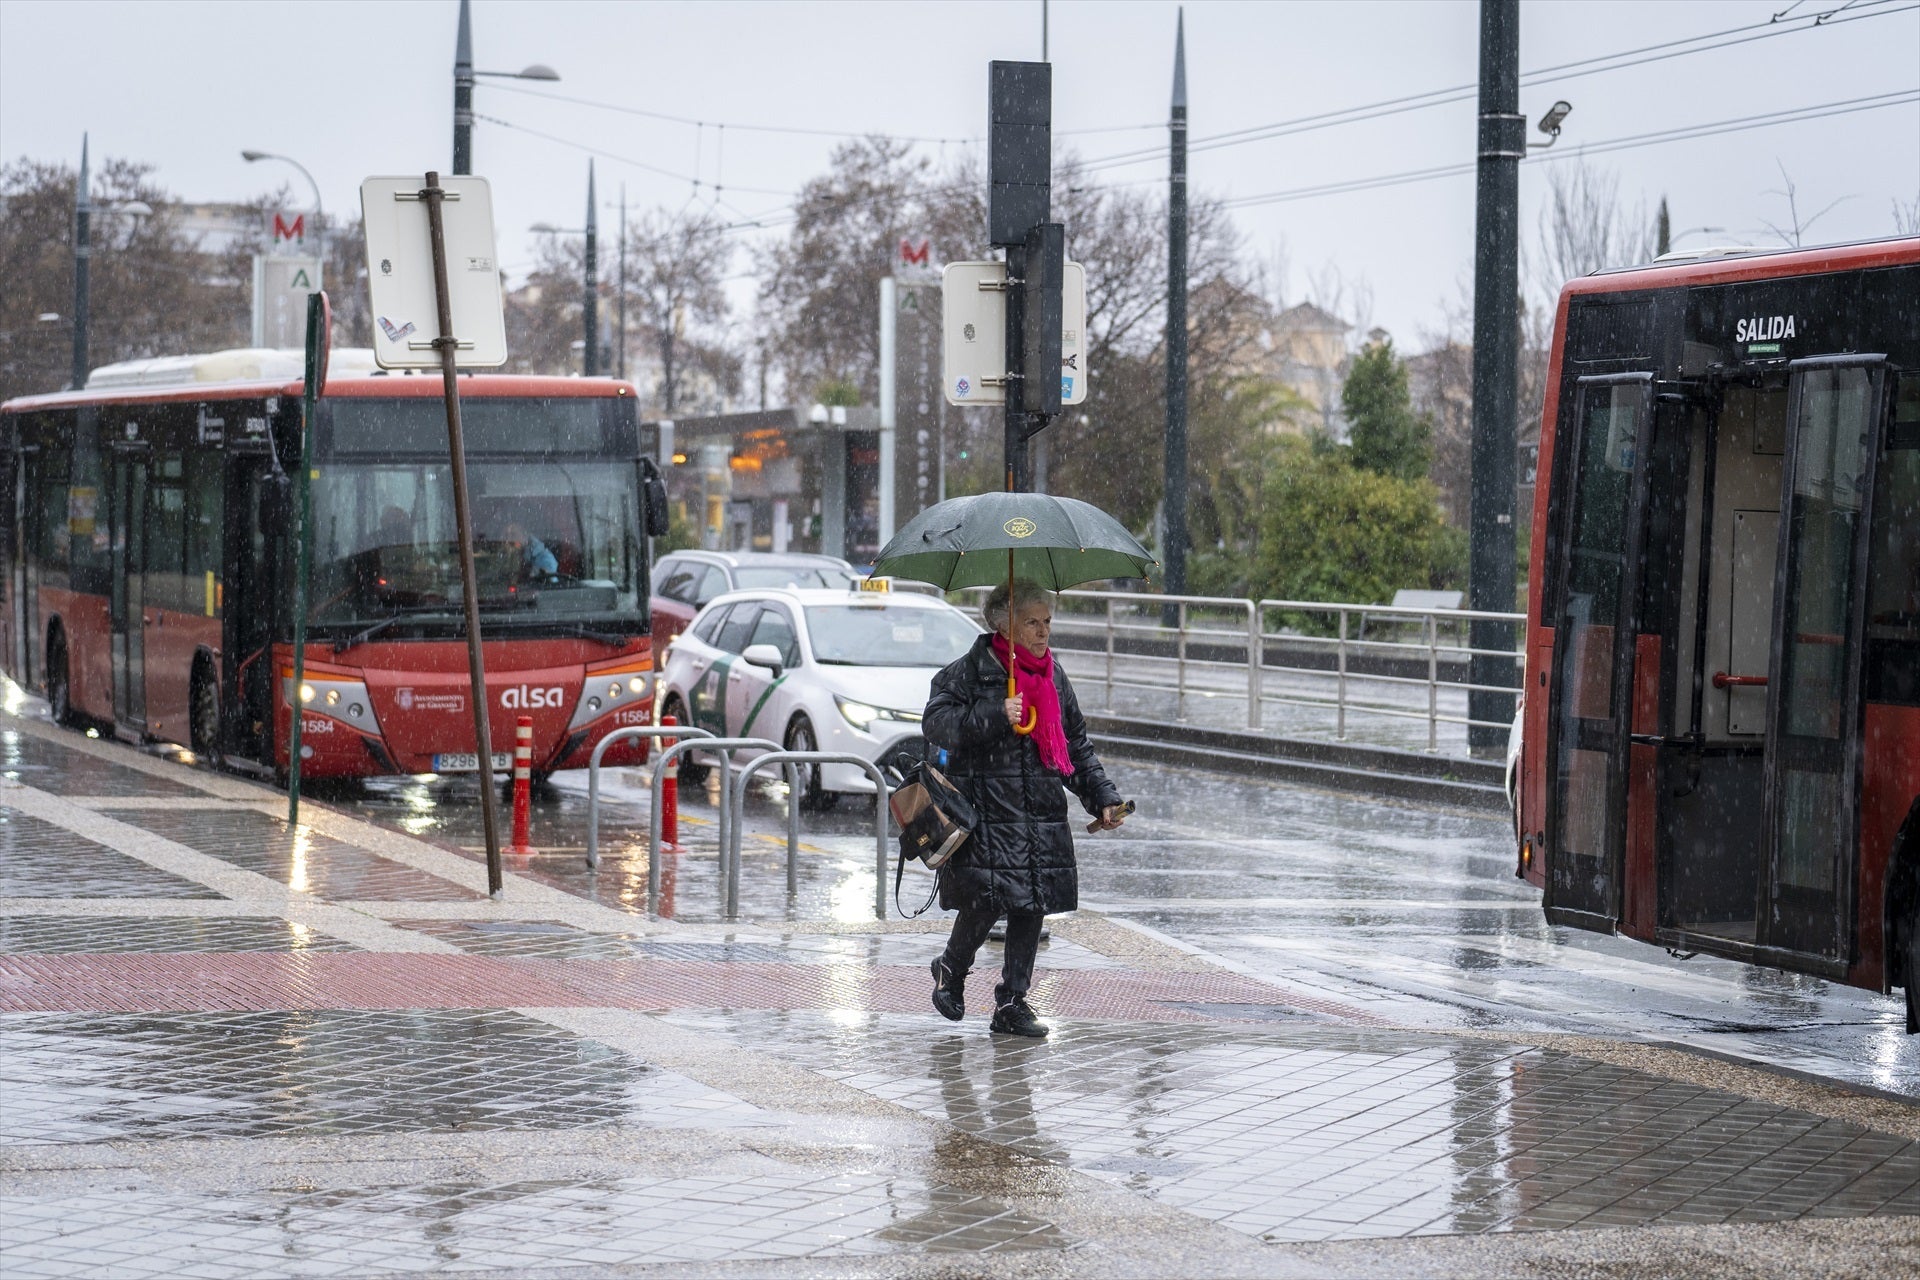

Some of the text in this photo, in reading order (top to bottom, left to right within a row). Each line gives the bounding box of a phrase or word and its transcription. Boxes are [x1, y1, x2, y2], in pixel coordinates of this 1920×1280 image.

[272, 212, 305, 244] M
[900, 239, 929, 269] M
[1736, 315, 1796, 343] SALIDA
[501, 684, 564, 709] alsa
[301, 719, 334, 733] 1584
[614, 710, 650, 724] 11584
[441, 754, 476, 768] 8296
